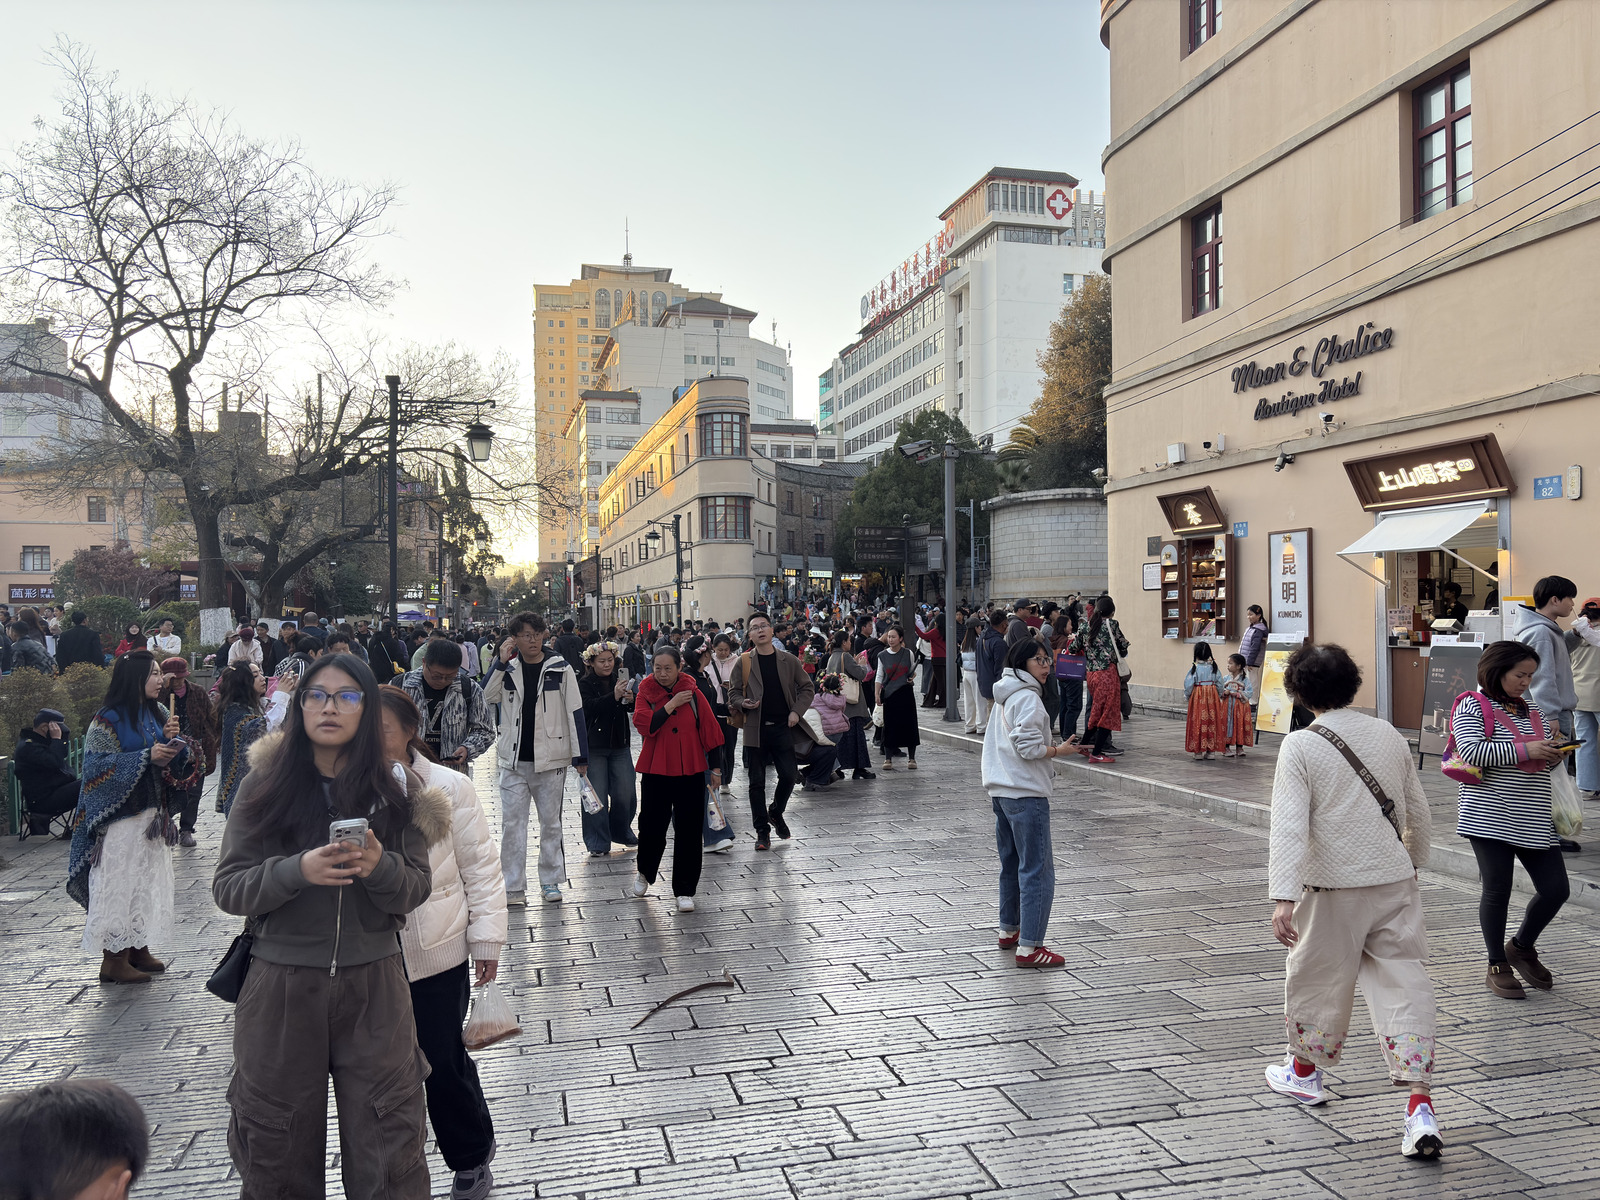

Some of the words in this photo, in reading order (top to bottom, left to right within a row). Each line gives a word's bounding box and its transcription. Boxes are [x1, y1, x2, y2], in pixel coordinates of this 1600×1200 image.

[1231, 361, 1286, 393] Moon
[1288, 346, 1308, 376] &
[1311, 322, 1392, 377] Chalice
[1254, 390, 1314, 420] Boutique
[1318, 371, 1362, 404] Hotel
[1379, 460, 1461, 492] 上山喝茶
[1541, 487, 1553, 497] 82
[1183, 503, 1202, 525] 茶
[1237, 529, 1244, 537] 84
[1282, 553, 1297, 604] 昆明
[11, 588, 37, 599] 菌彩
[1278, 610, 1303, 619] KUNMING
[1318, 727, 1345, 750] BSTO
[1359, 767, 1380, 794] BSTO
